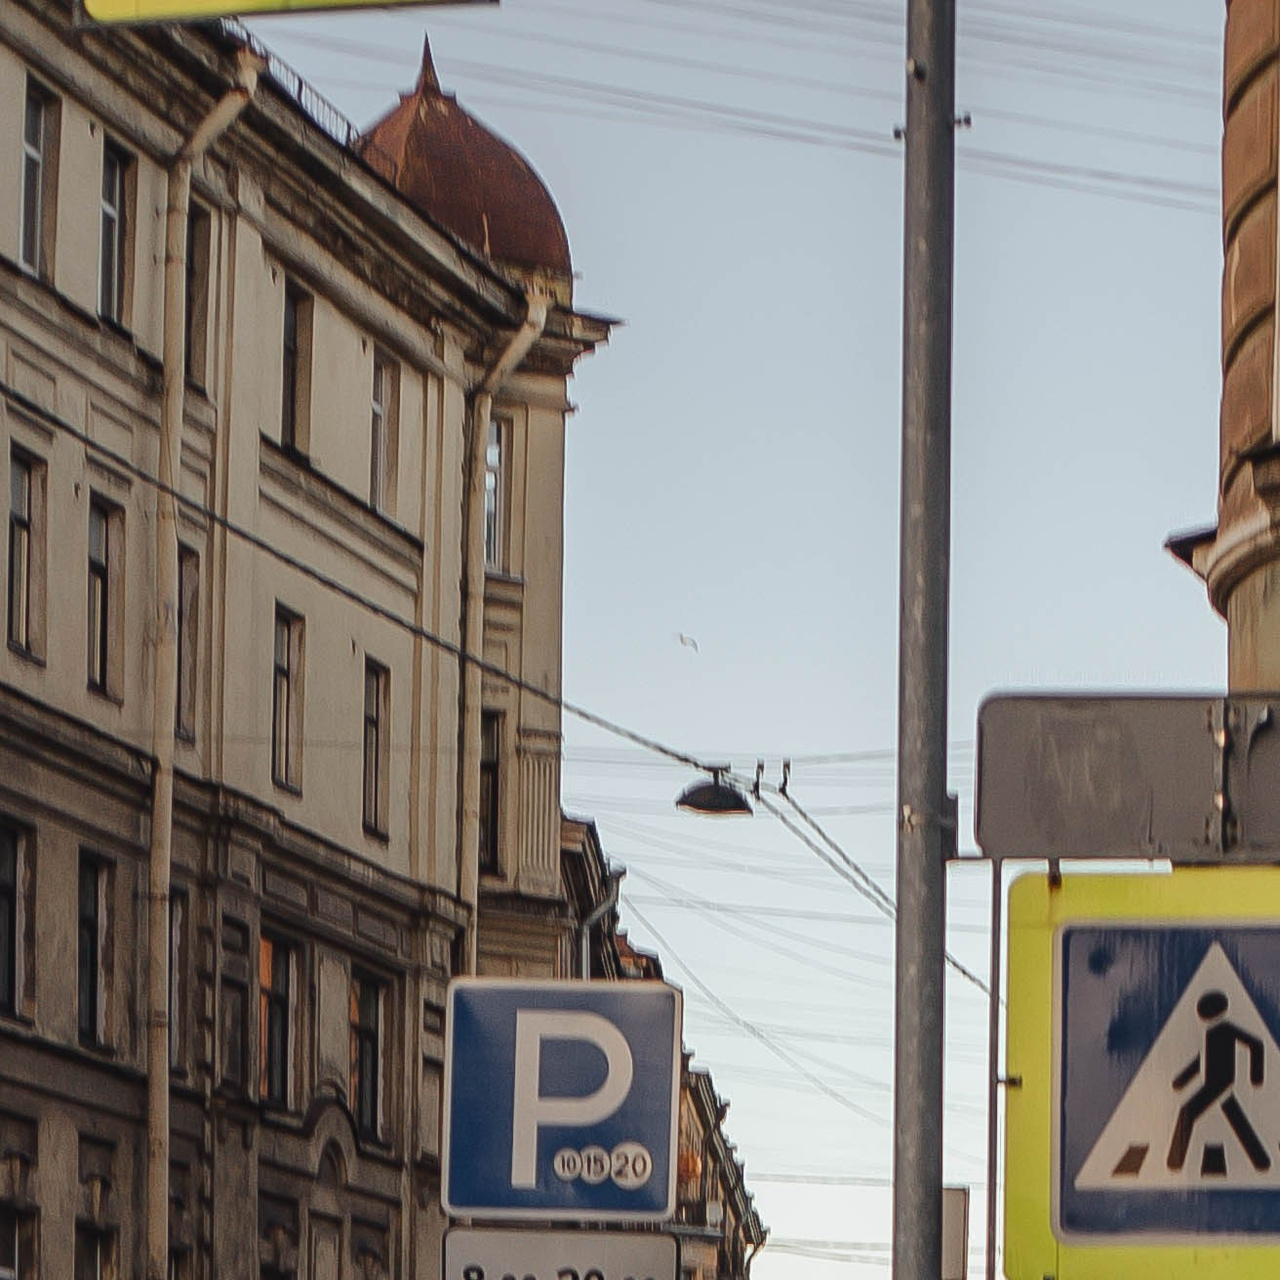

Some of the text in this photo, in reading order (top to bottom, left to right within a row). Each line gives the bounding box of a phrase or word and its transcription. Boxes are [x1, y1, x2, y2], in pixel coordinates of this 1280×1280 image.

[510, 1007, 634, 1190] P
[561, 1151, 647, 1179] 10 15 20
